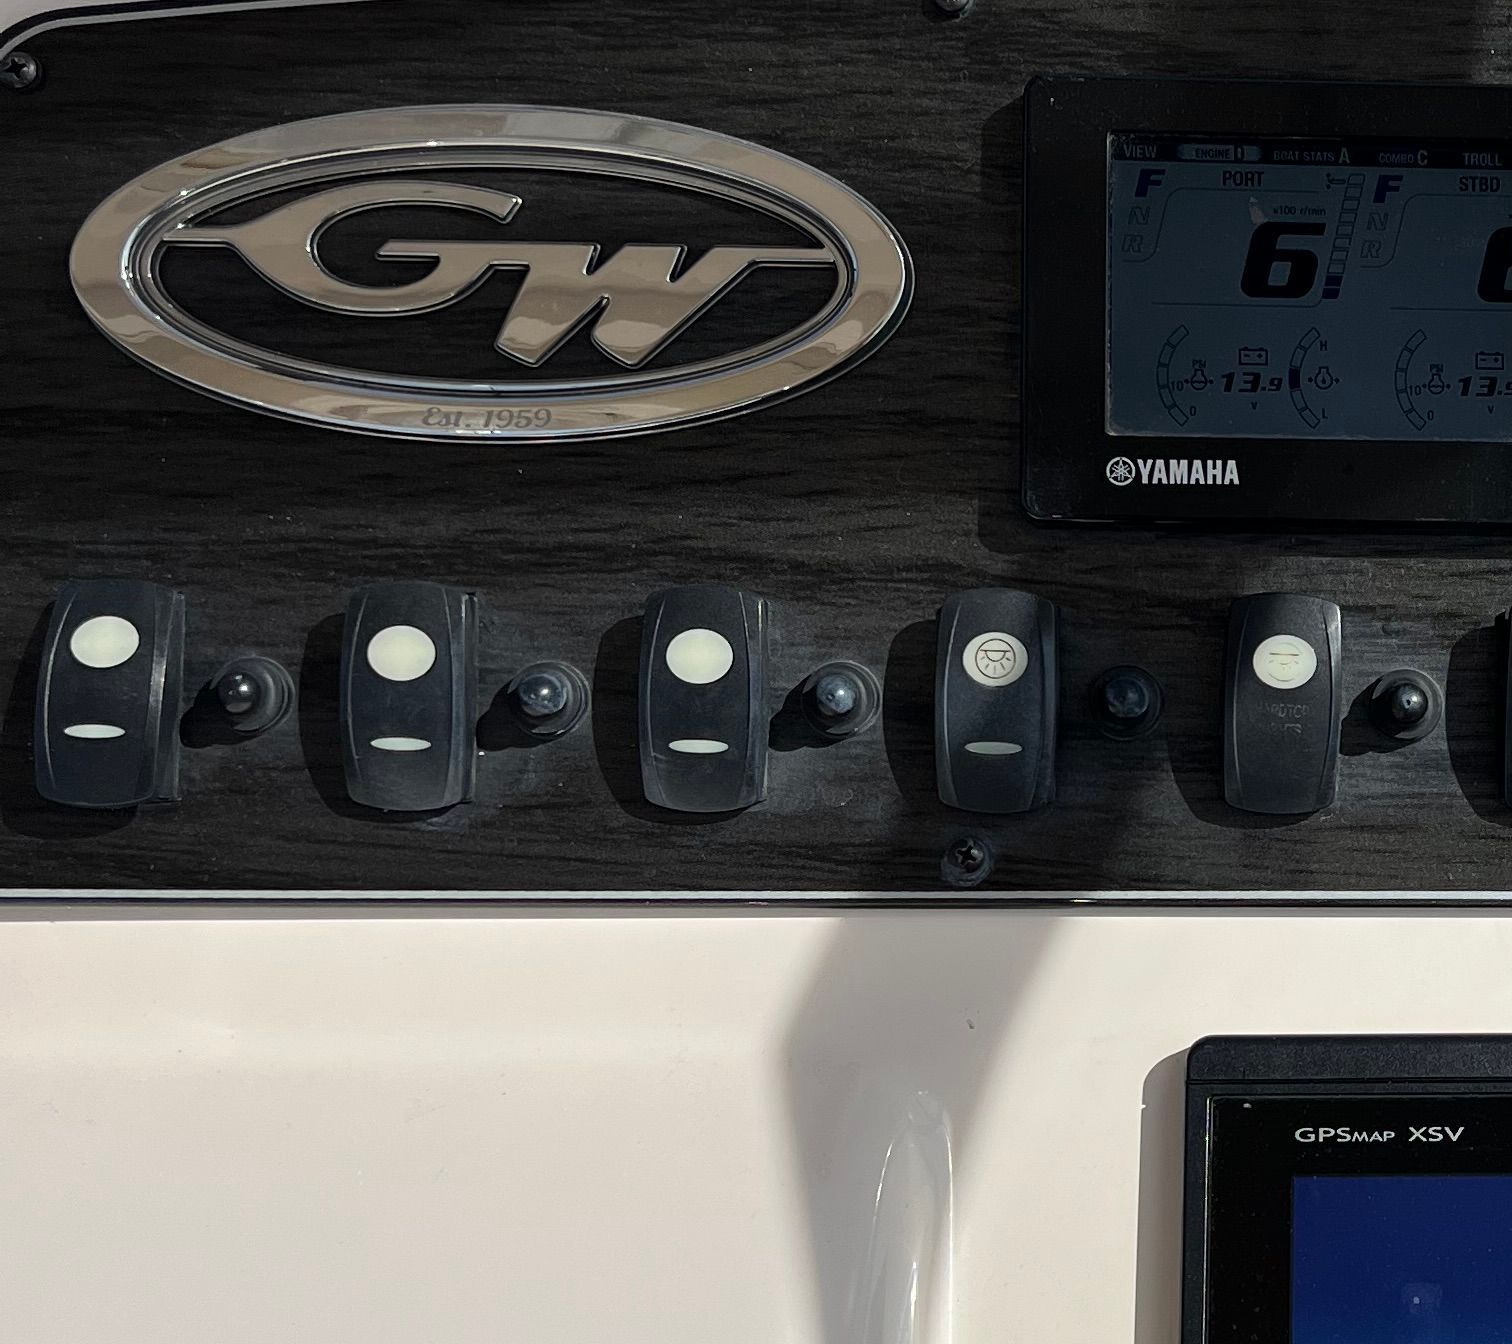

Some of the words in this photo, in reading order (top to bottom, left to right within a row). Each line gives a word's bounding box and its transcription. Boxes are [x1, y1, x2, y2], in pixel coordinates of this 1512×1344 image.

[1123, 145, 1157, 158] VIEW
[1195, 148, 1232, 160] ENGINE
[1273, 150, 1299, 161] BOAT
[1303, 151, 1335, 162] STATS
[1338, 147, 1350, 163] A
[1417, 149, 1428, 165] C
[1462, 152, 1503, 167] TROLL
[1134, 169, 1166, 198] F
[1222, 170, 1264, 187] PORT
[1373, 175, 1403, 203] F
[1459, 176, 1501, 193] STBD
[1240, 221, 1327, 300] 6
[1320, 340, 1328, 351] H
[1171, 380, 1184, 391] 10
[1221, 372, 1283, 392] 13.9
[1408, 385, 1422, 396] 10
[483, 408, 552, 428] 1959
[1137, 459, 1240, 485] YAMAHA
[1408, 1126, 1465, 1142] XSV
